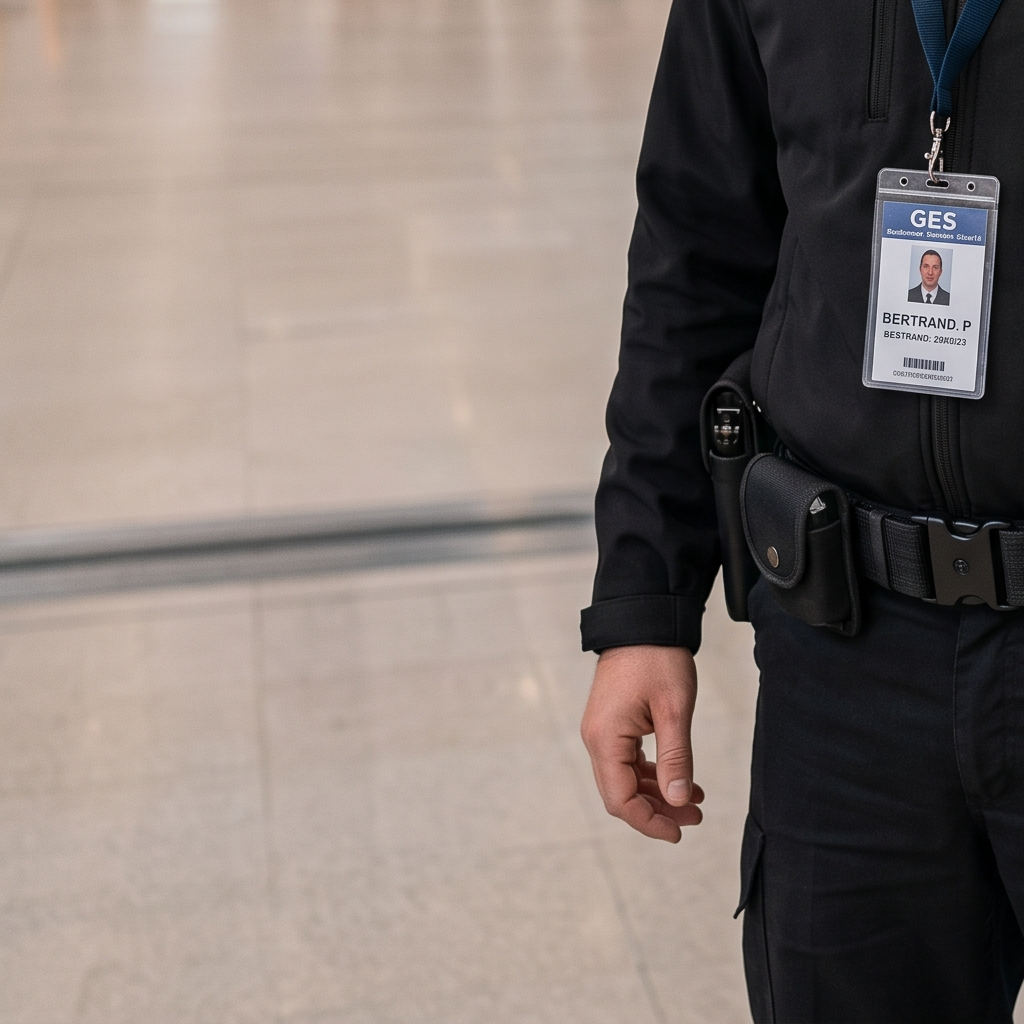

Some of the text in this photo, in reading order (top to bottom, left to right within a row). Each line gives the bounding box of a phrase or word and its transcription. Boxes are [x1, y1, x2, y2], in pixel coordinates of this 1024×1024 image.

[909, 209, 957, 231] GES
[882, 312, 972, 332] BERTRAND. P
[883, 330, 932, 343] BESTRAND:
